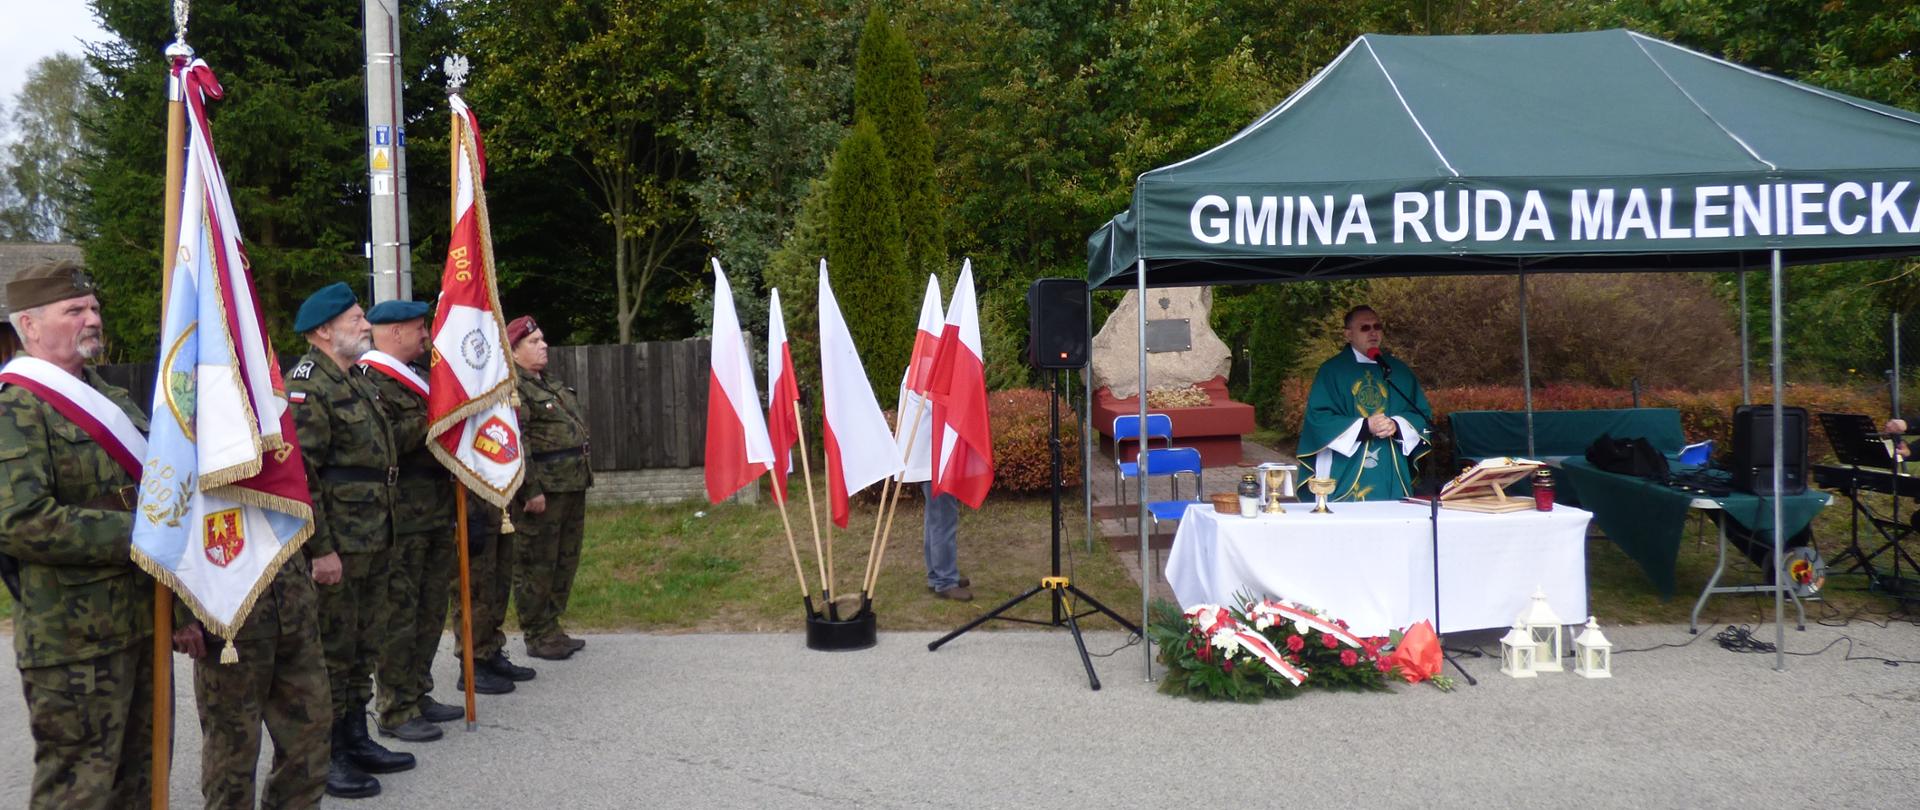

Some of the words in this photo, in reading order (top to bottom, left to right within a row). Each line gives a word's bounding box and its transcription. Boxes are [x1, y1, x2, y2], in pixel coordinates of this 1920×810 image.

[1190, 194, 1377, 246] GMINA
[1394, 190, 1555, 244] RUDA
[450, 246, 472, 281] BÓG
